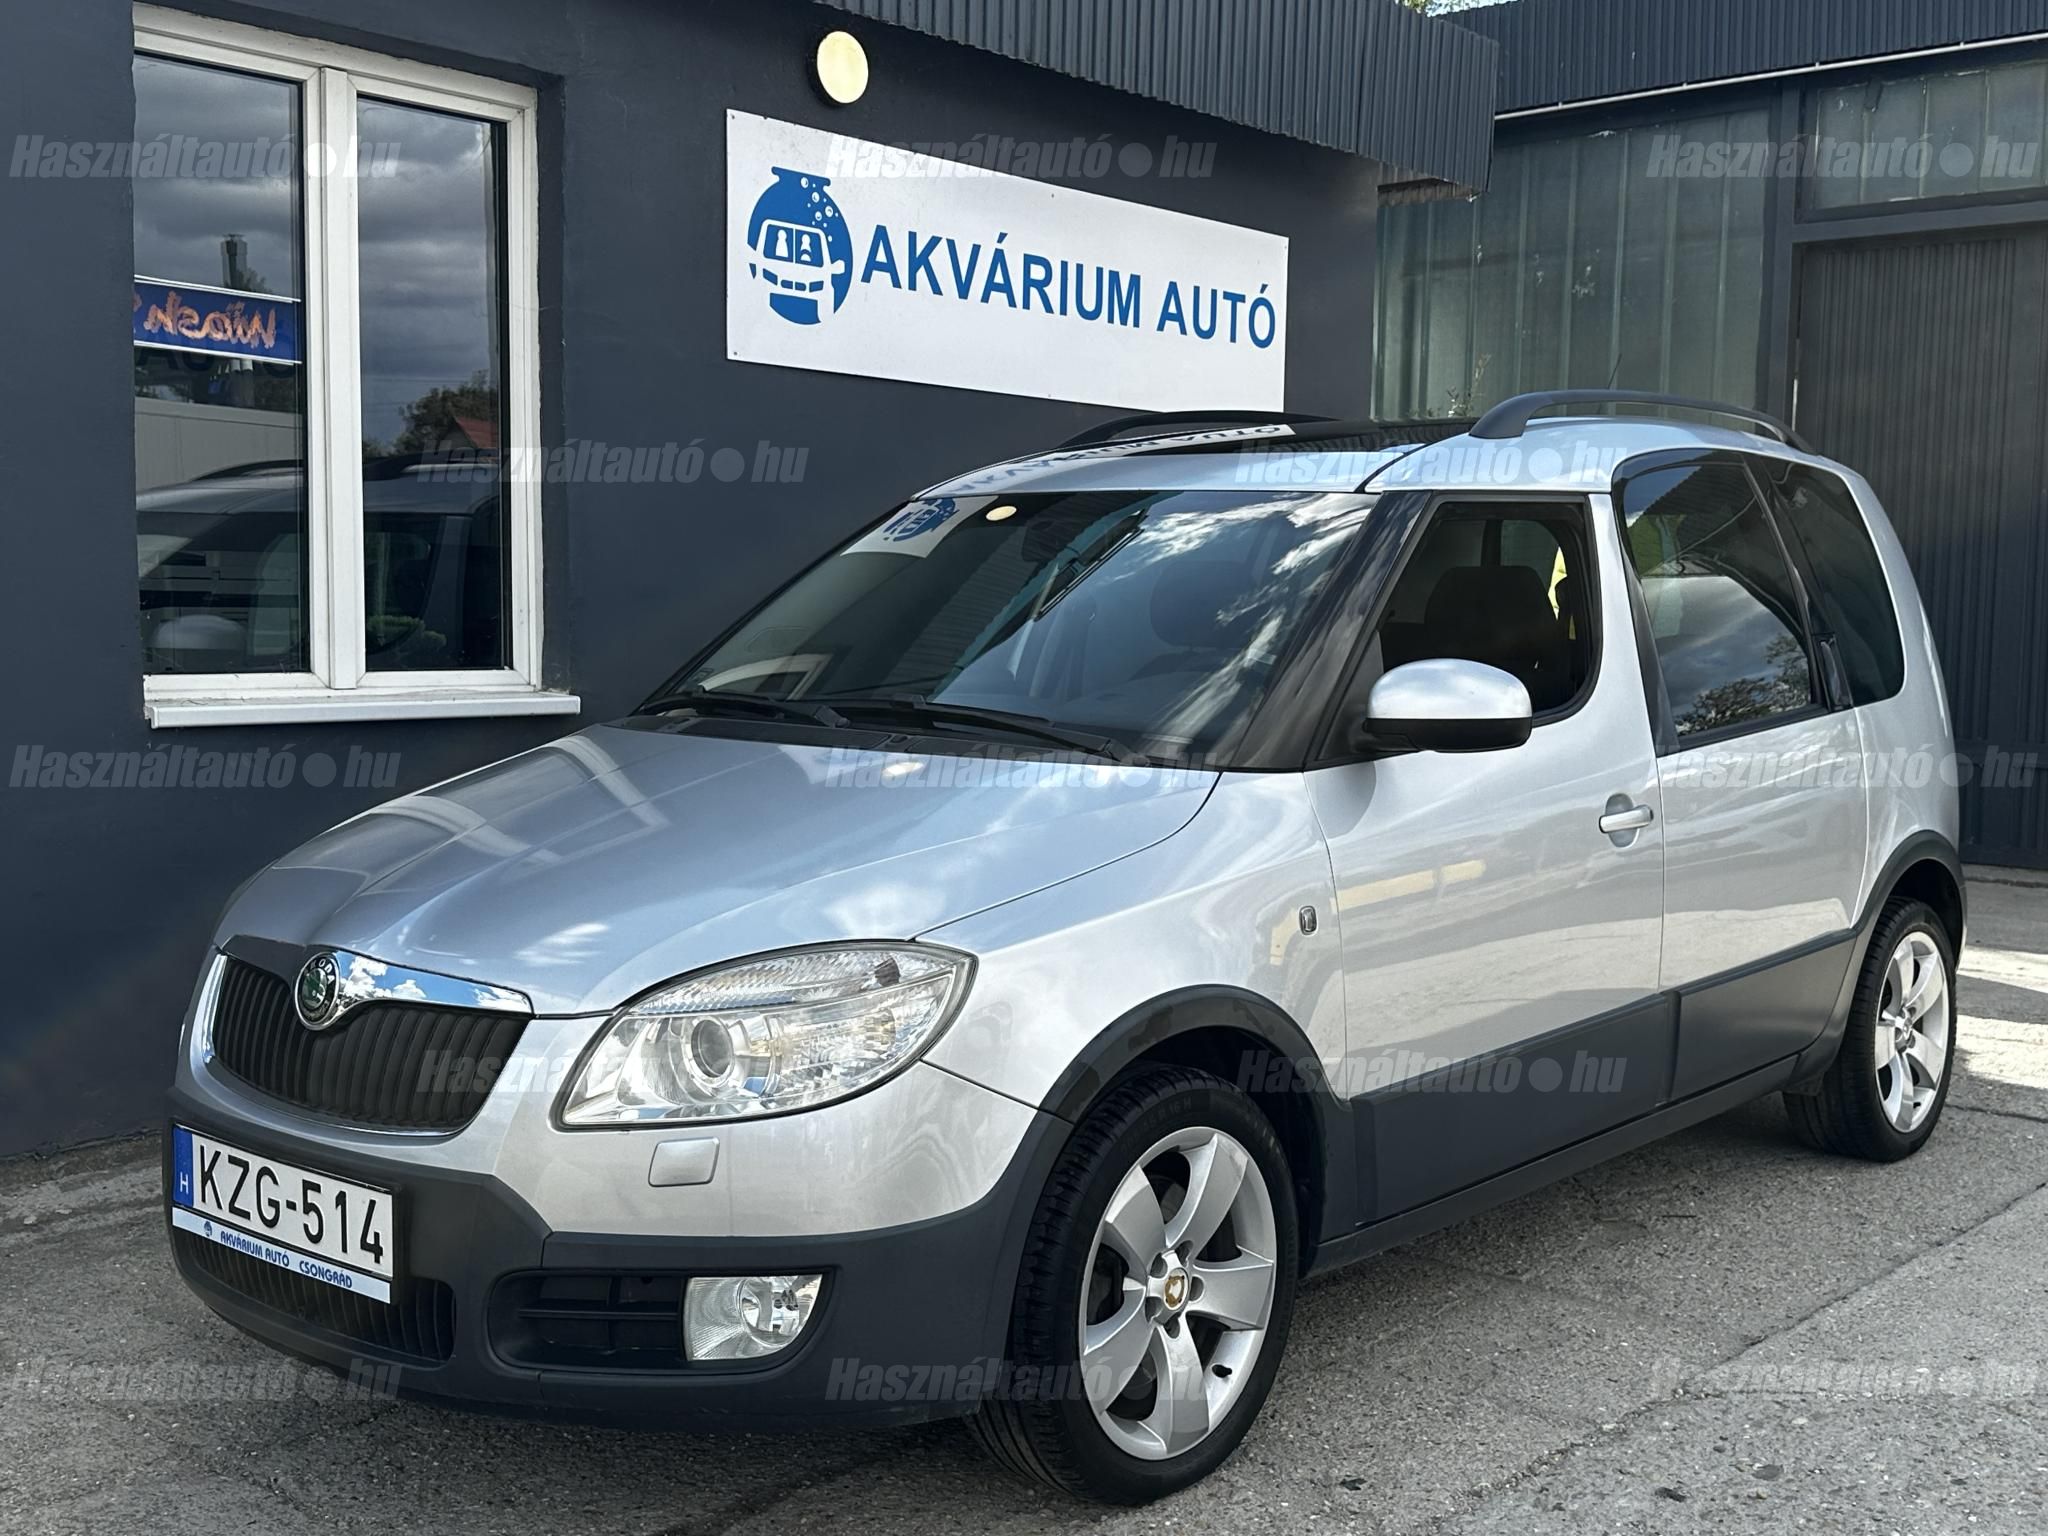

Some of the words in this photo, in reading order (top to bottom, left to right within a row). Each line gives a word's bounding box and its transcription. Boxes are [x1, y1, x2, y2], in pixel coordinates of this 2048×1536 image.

[861, 224, 1141, 329] AKVÁRIUM
[1156, 280, 1276, 349] AUTÓ
[180, 1171, 189, 1195] H
[200, 1145, 384, 1264] KZG-514
[220, 1230, 263, 1258] AKVÁRIUM
[265, 1248, 290, 1267] AUTÓ
[299, 1260, 353, 1289] CSONGRÁD
